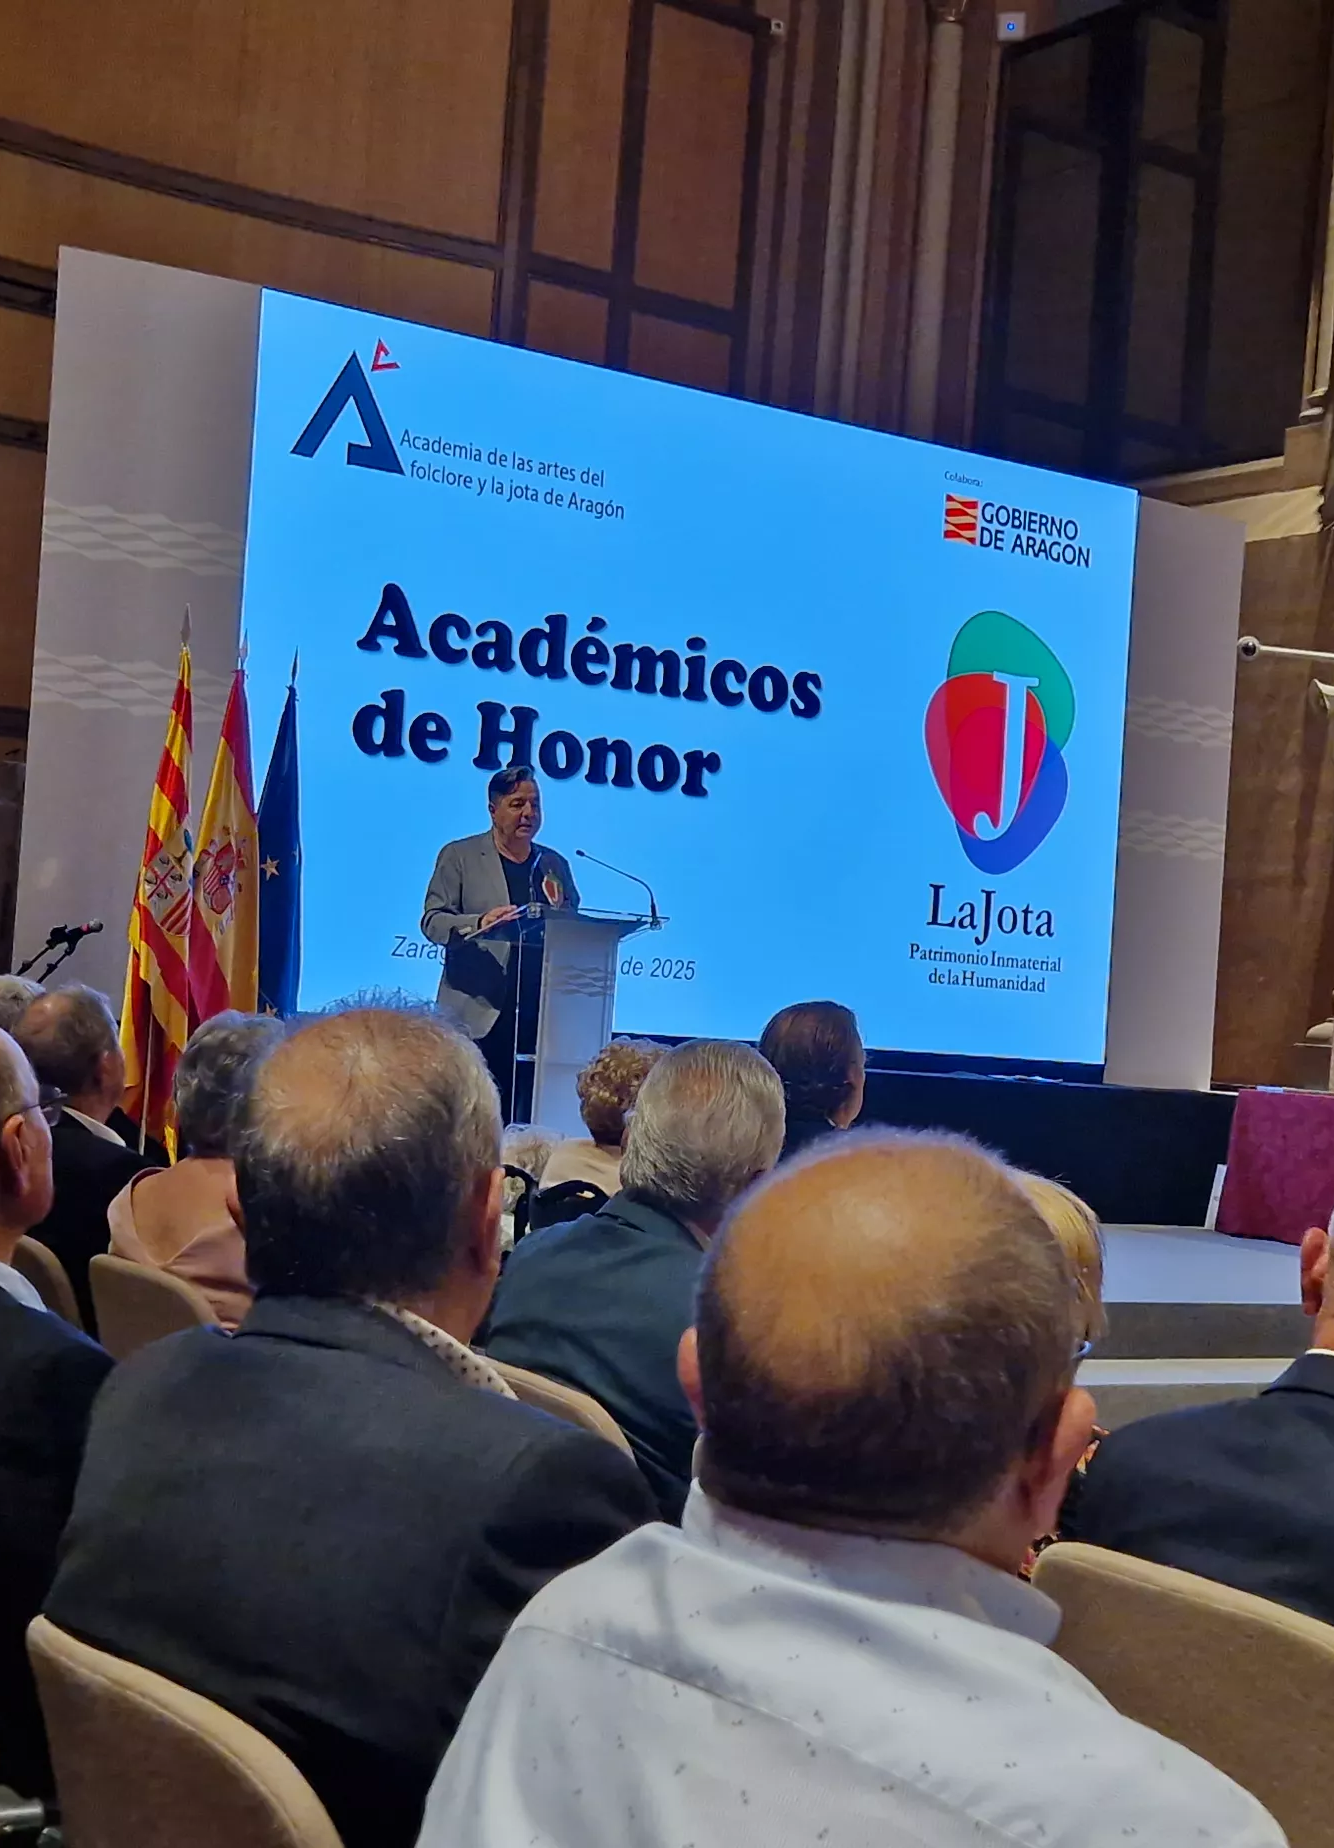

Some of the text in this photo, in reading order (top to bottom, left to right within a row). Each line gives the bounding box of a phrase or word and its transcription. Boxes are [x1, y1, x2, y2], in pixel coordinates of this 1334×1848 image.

[400, 428, 605, 488] Academia de las artes del
[944, 470, 983, 487] Colabora:
[410, 459, 625, 520] folclore y la jota de Aragón
[981, 501, 1079, 541] GOBIERNO
[979, 525, 1091, 569] DE ARAGON
[356, 582, 824, 719] Académicos
[352, 688, 722, 798] de Honor
[925, 883, 1055, 946] LaJota
[620, 956, 643, 976] de
[650, 957, 696, 981] 2025
[908, 942, 1062, 973] Patrimonio Inmaterial
[928, 968, 1046, 993] de la Humanidad
